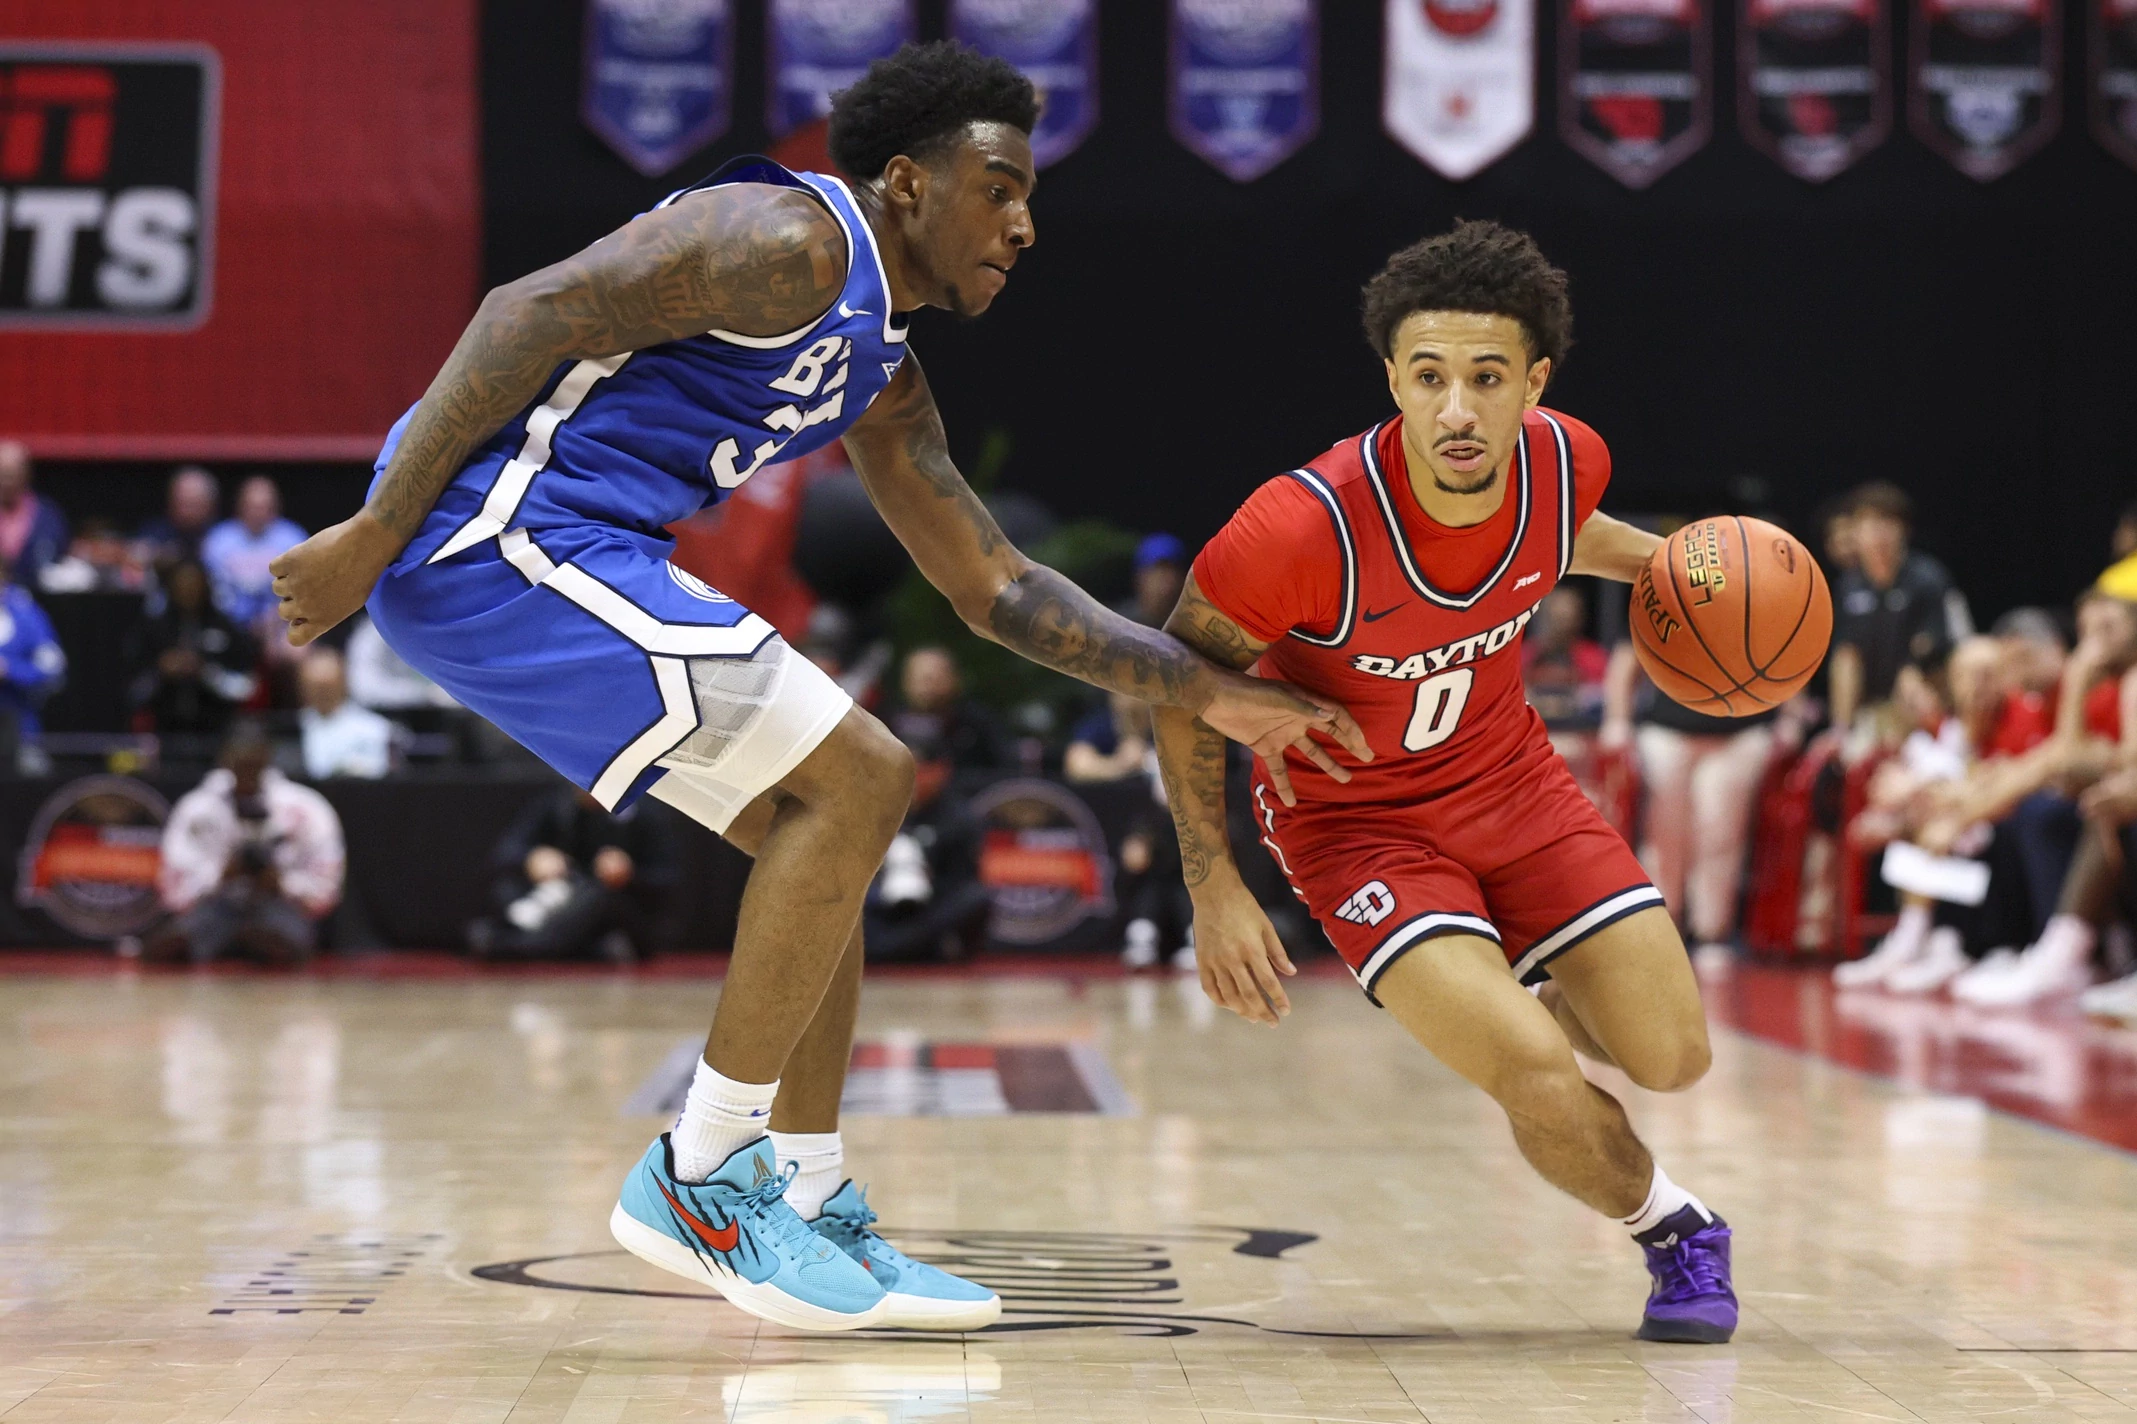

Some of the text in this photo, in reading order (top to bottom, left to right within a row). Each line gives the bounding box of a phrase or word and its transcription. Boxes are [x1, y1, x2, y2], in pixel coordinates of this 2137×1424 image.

[0, 186, 196, 306] TS
[1684, 525, 1713, 607] LEGAC
[1353, 598, 1542, 680] DAYTON
[1402, 666, 1474, 753] 0
